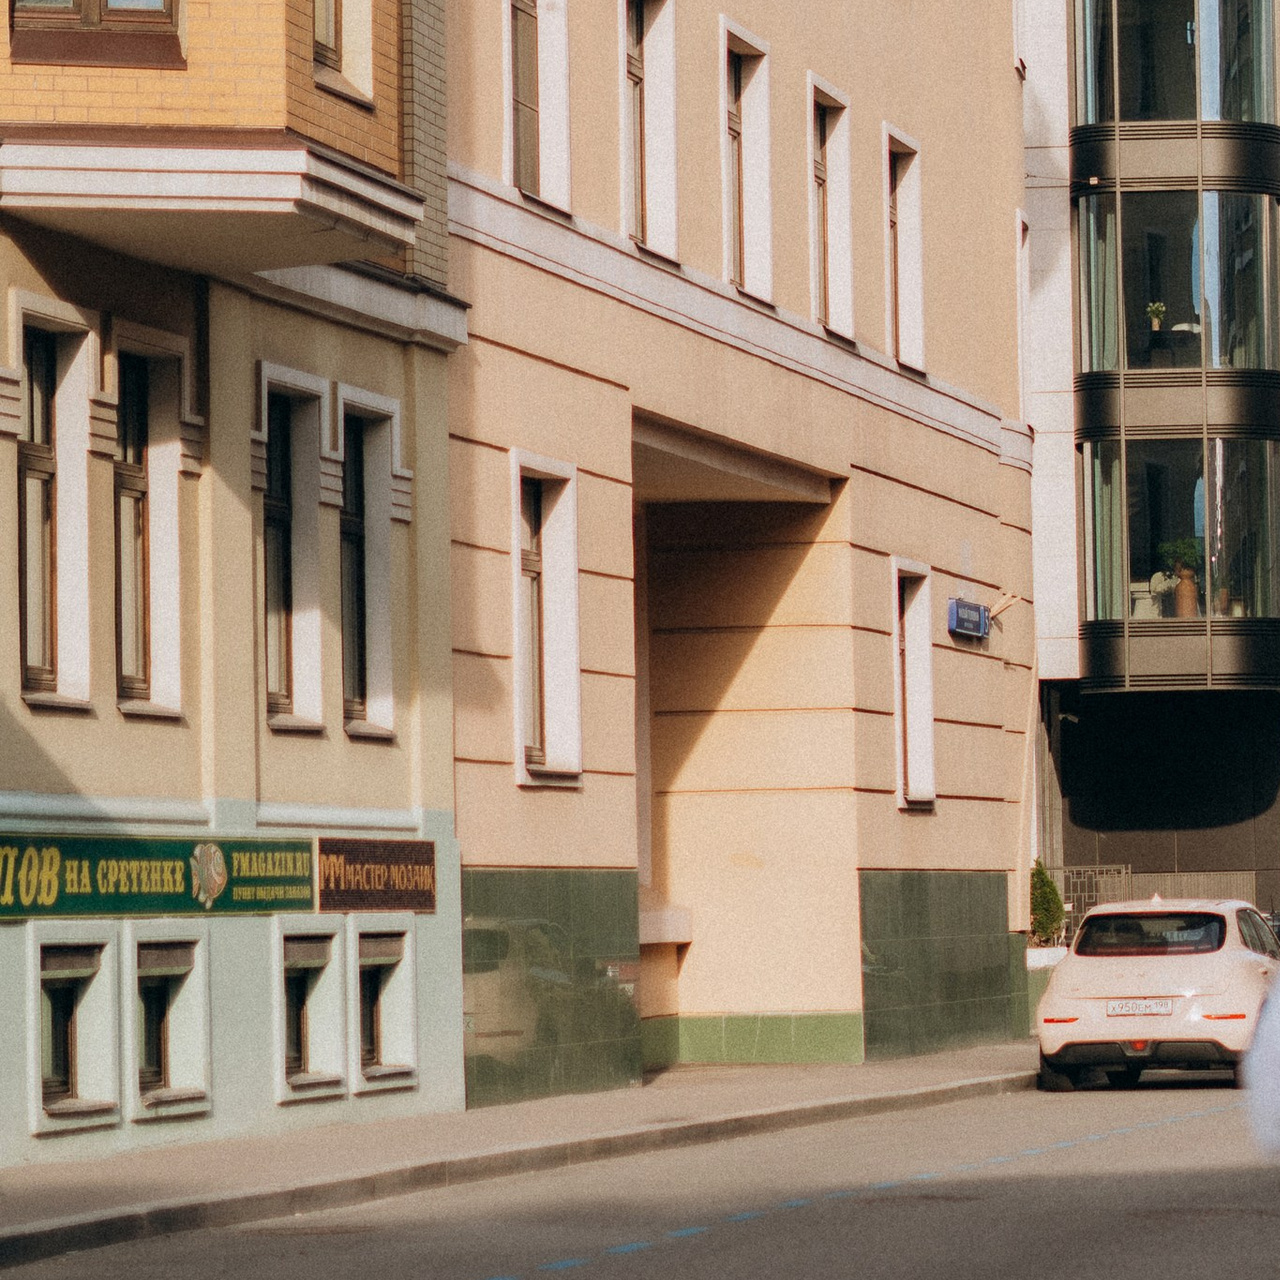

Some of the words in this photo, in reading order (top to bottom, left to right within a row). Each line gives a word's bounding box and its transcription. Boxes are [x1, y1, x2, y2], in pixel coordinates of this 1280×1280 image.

[65, 860, 92, 893] НА
[96, 859, 185, 893] СРЕТЕНКЕ
[345, 864, 387, 890] МАСТЕР
